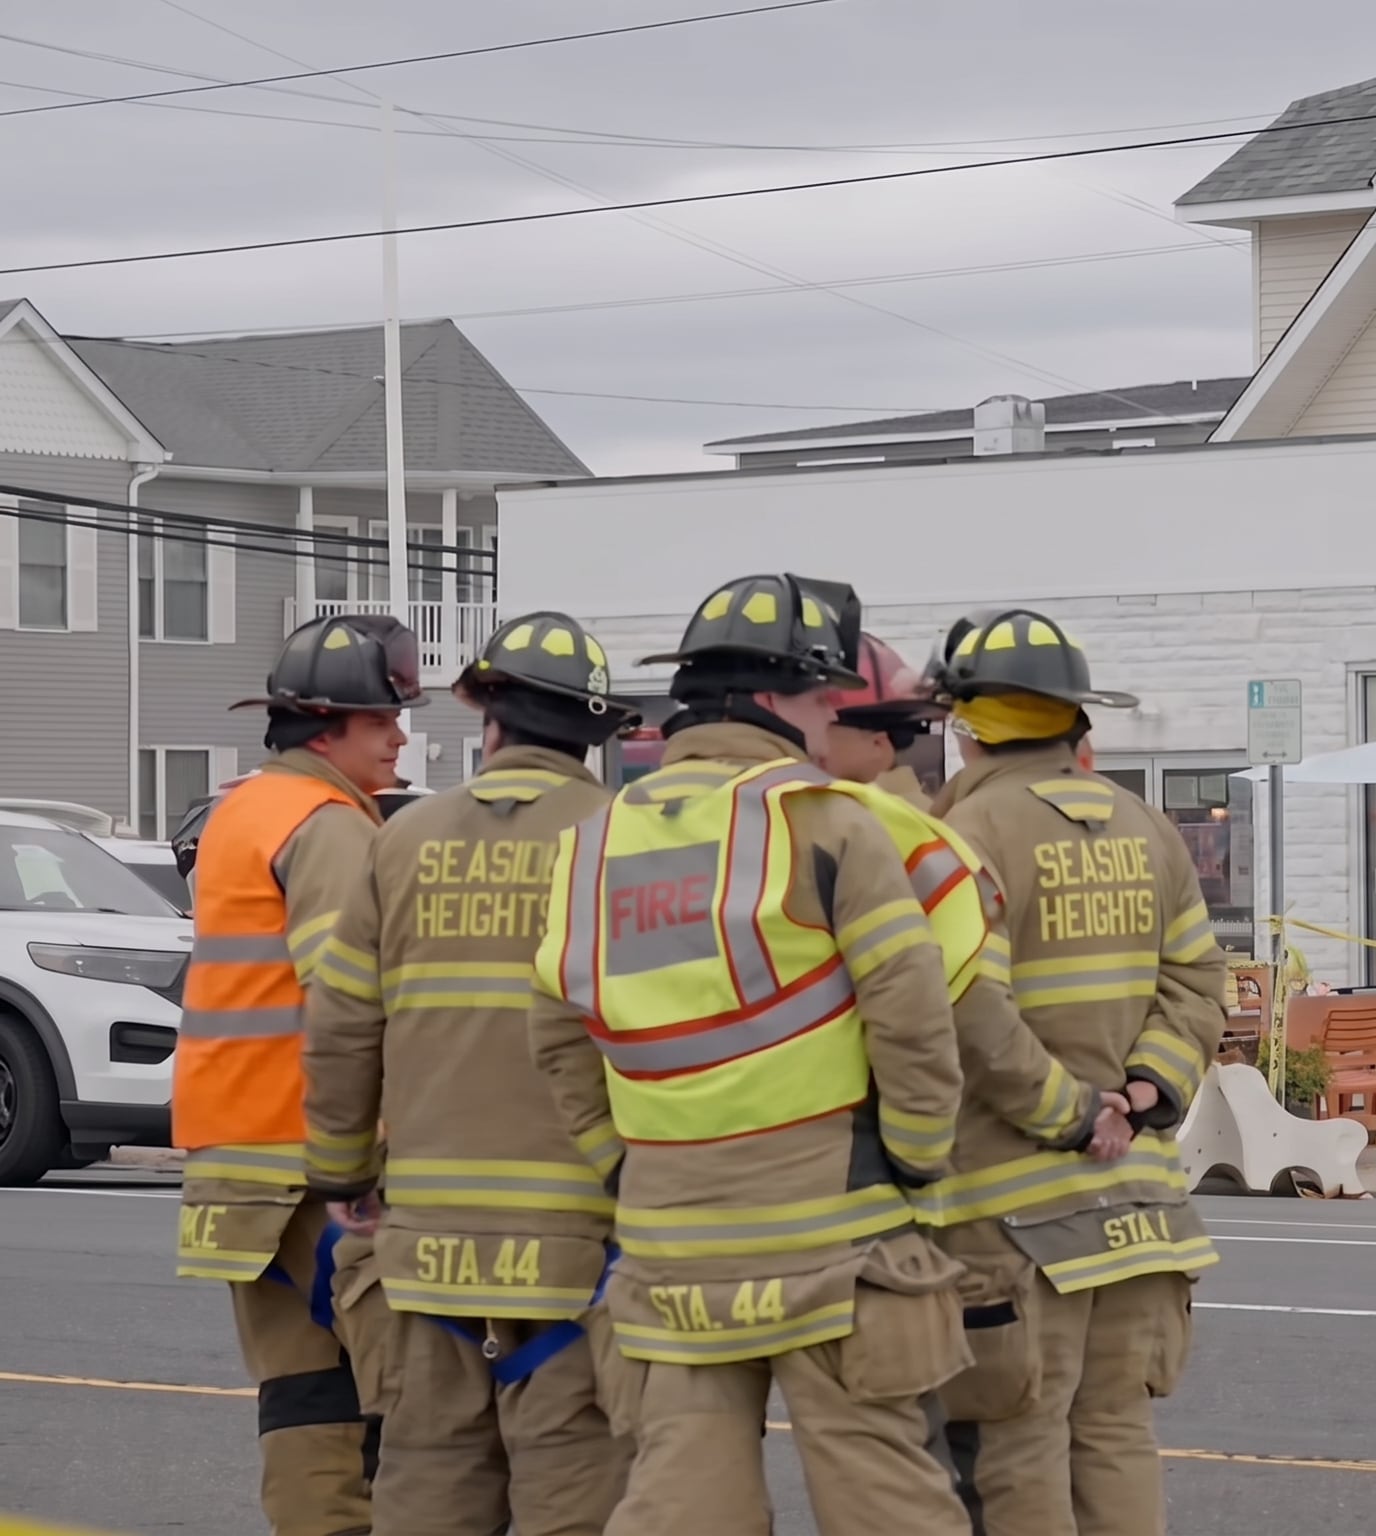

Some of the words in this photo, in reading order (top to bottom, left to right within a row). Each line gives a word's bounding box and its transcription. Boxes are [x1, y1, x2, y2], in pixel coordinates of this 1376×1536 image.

[1033, 837, 1154, 889] SEASIDE
[610, 875, 710, 942] FIRE
[1040, 889, 1153, 942] HEIGHTS
[416, 1236, 487, 1285] STA.
[493, 1238, 540, 1286] 44
[649, 1284, 724, 1332] STA.
[731, 1277, 785, 1326] 44
